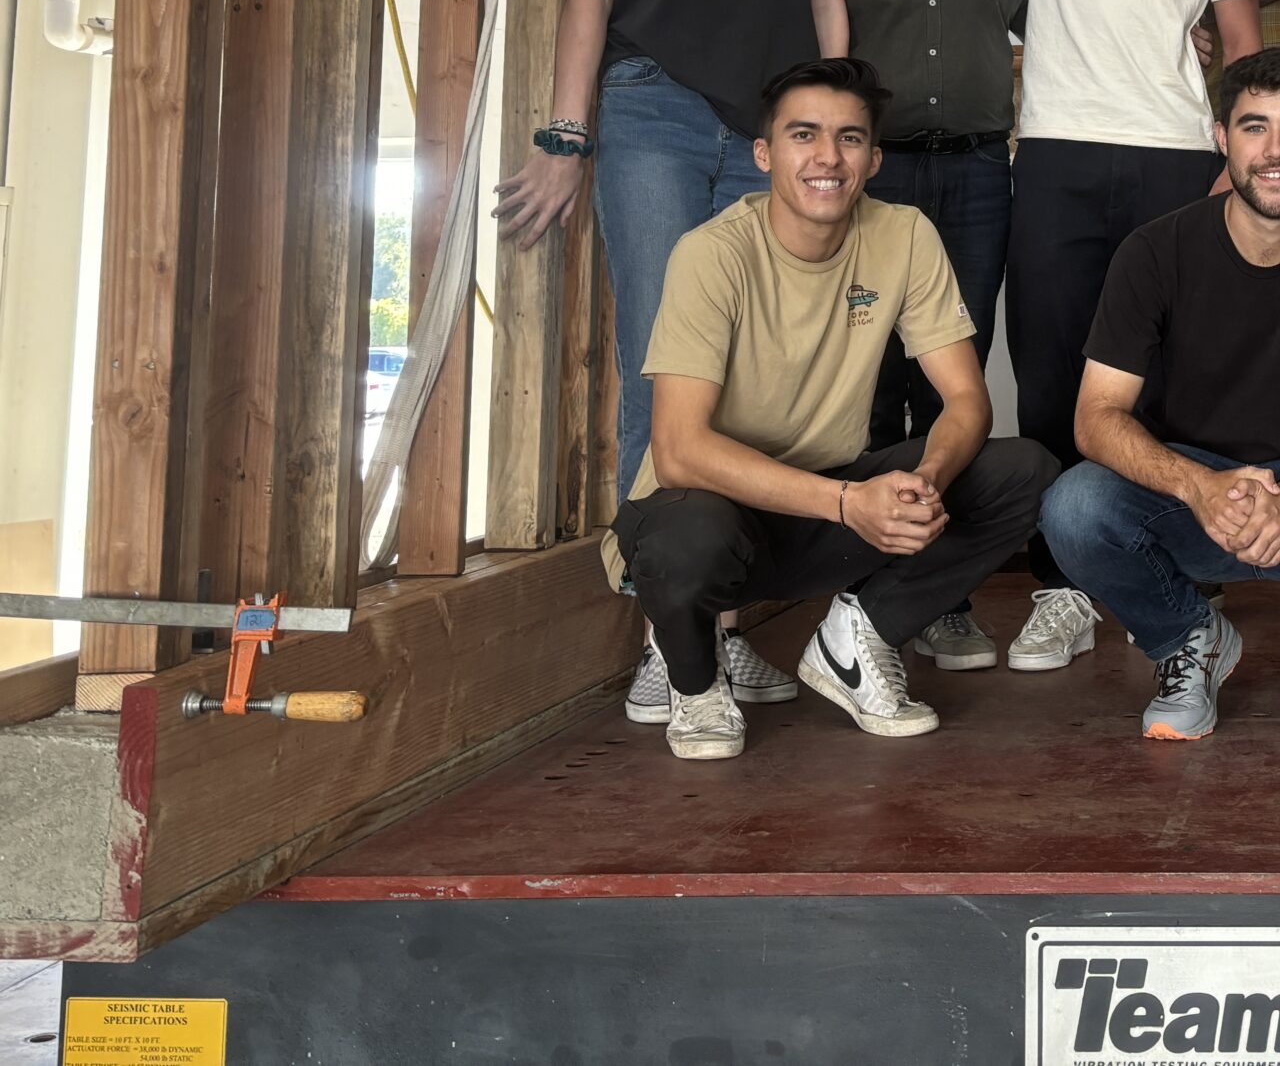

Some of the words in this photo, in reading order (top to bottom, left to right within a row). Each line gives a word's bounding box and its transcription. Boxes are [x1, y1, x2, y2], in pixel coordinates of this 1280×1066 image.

[107, 1004, 150, 1013] SEISMIC
[152, 1004, 185, 1013] TABLE
[104, 1016, 188, 1025] SPECIFICATIONS
[67, 1036, 90, 1044] TABLE
[91, 1036, 107, 1044] SIZE
